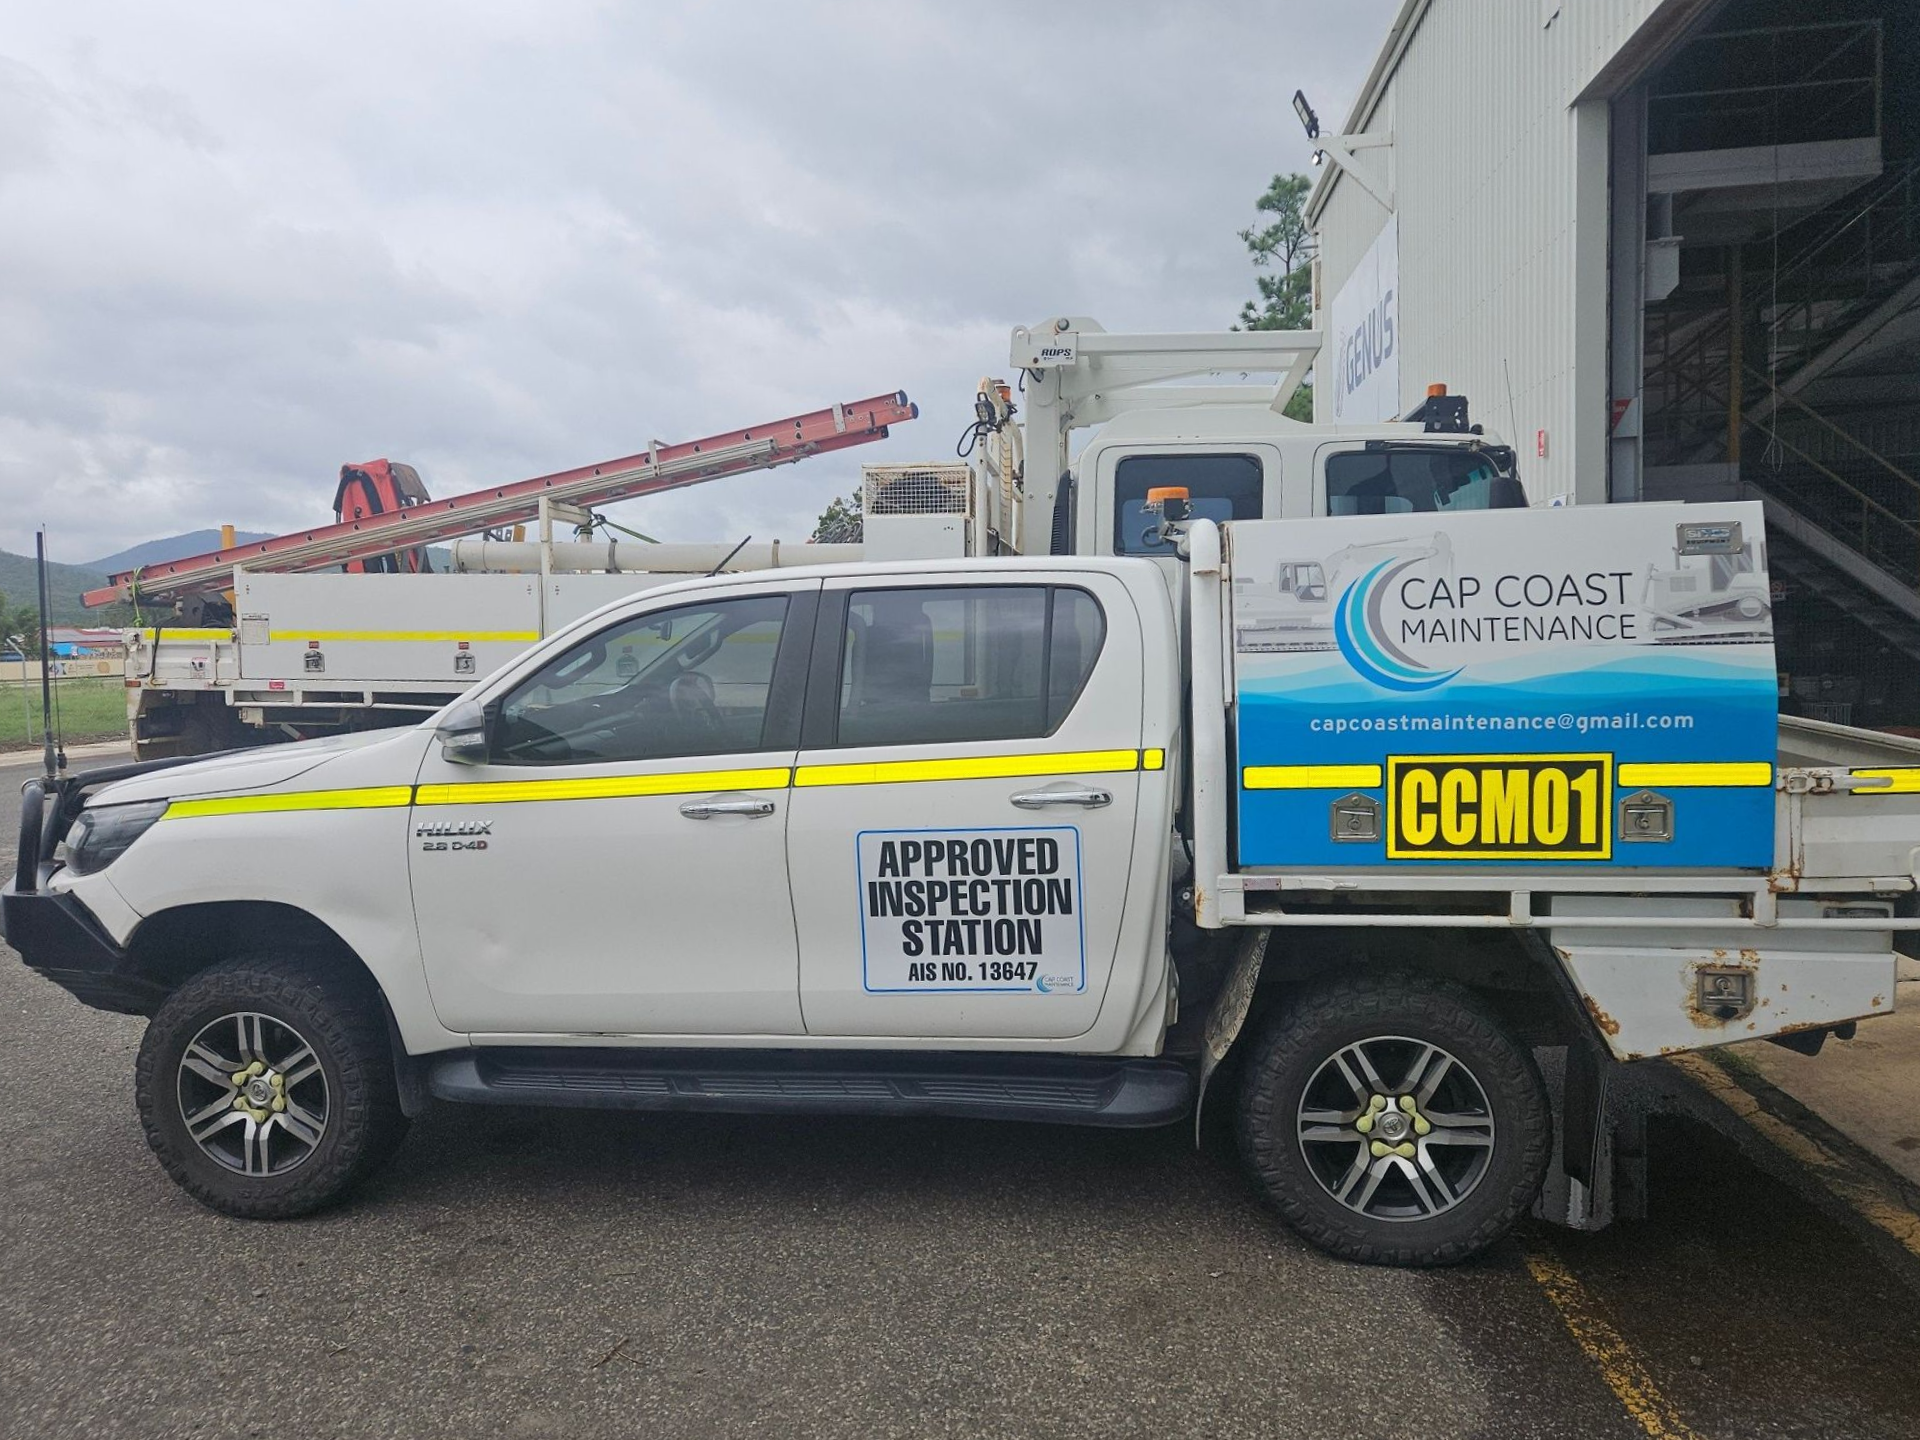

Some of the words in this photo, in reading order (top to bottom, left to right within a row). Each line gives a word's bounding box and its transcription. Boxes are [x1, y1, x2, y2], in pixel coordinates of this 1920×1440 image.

[1346, 289, 1394, 395] GENUS
[1400, 577, 1481, 610] CAP
[1495, 572, 1633, 608] COAST
[1401, 614, 1637, 643] MAINTENANCE
[1310, 713, 1694, 734] capcoastmaintenance@gmail.com
[1401, 767, 1597, 846] CCM01
[416, 820, 494, 837] HILUX
[423, 842, 447, 851] 2.8
[878, 838, 1059, 877] APPROVED
[868, 878, 1073, 917] INSPECTION
[902, 918, 1043, 956] STATION
[908, 962, 936, 981] AIS
[942, 962, 972, 981] NO.
[979, 961, 1038, 981] 13647
